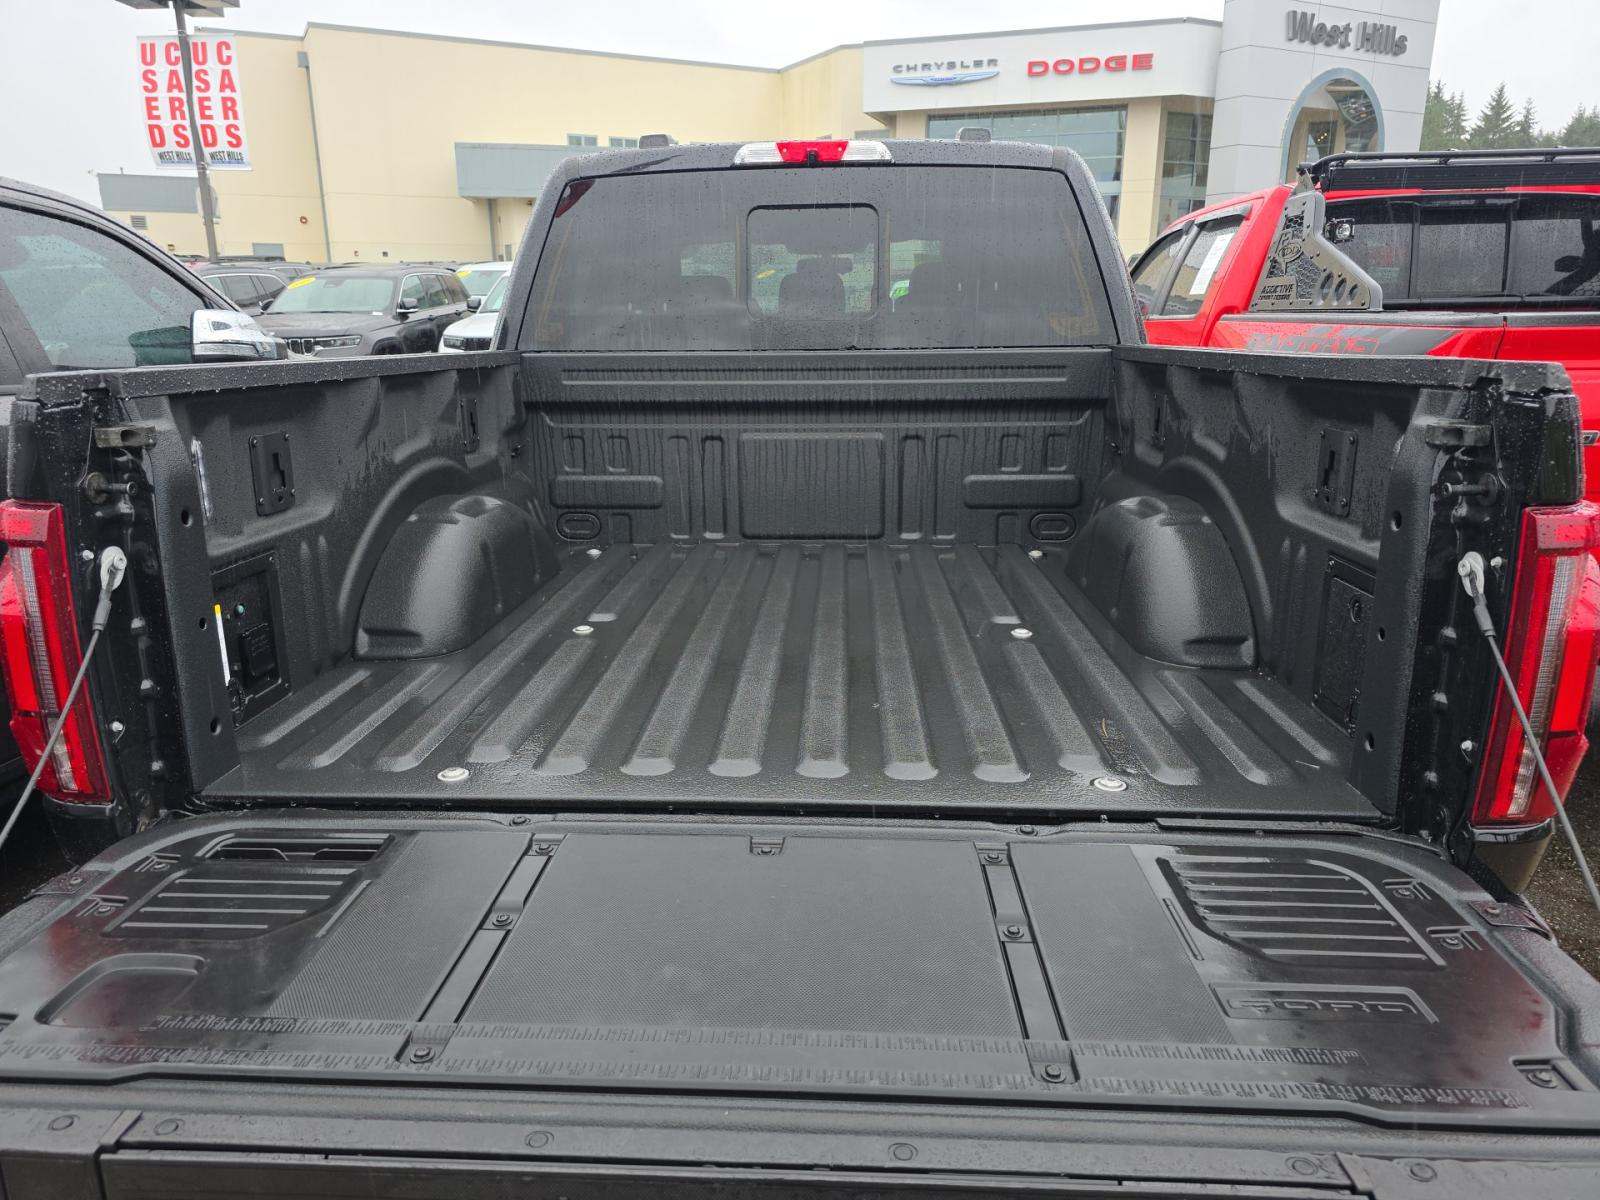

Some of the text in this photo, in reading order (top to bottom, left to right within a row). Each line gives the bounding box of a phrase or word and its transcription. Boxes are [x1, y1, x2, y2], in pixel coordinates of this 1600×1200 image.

[1285, 10, 1408, 56] West Hills
[892, 58, 998, 74] CHRYSLER
[1027, 53, 1154, 77] DODGE
[140, 42, 166, 148] USED
[164, 42, 190, 148] CARS
[191, 41, 218, 148] USED
[216, 40, 243, 148] CARS
[157, 151, 175, 161] WEST
[208, 150, 245, 162] WEST HILLS
